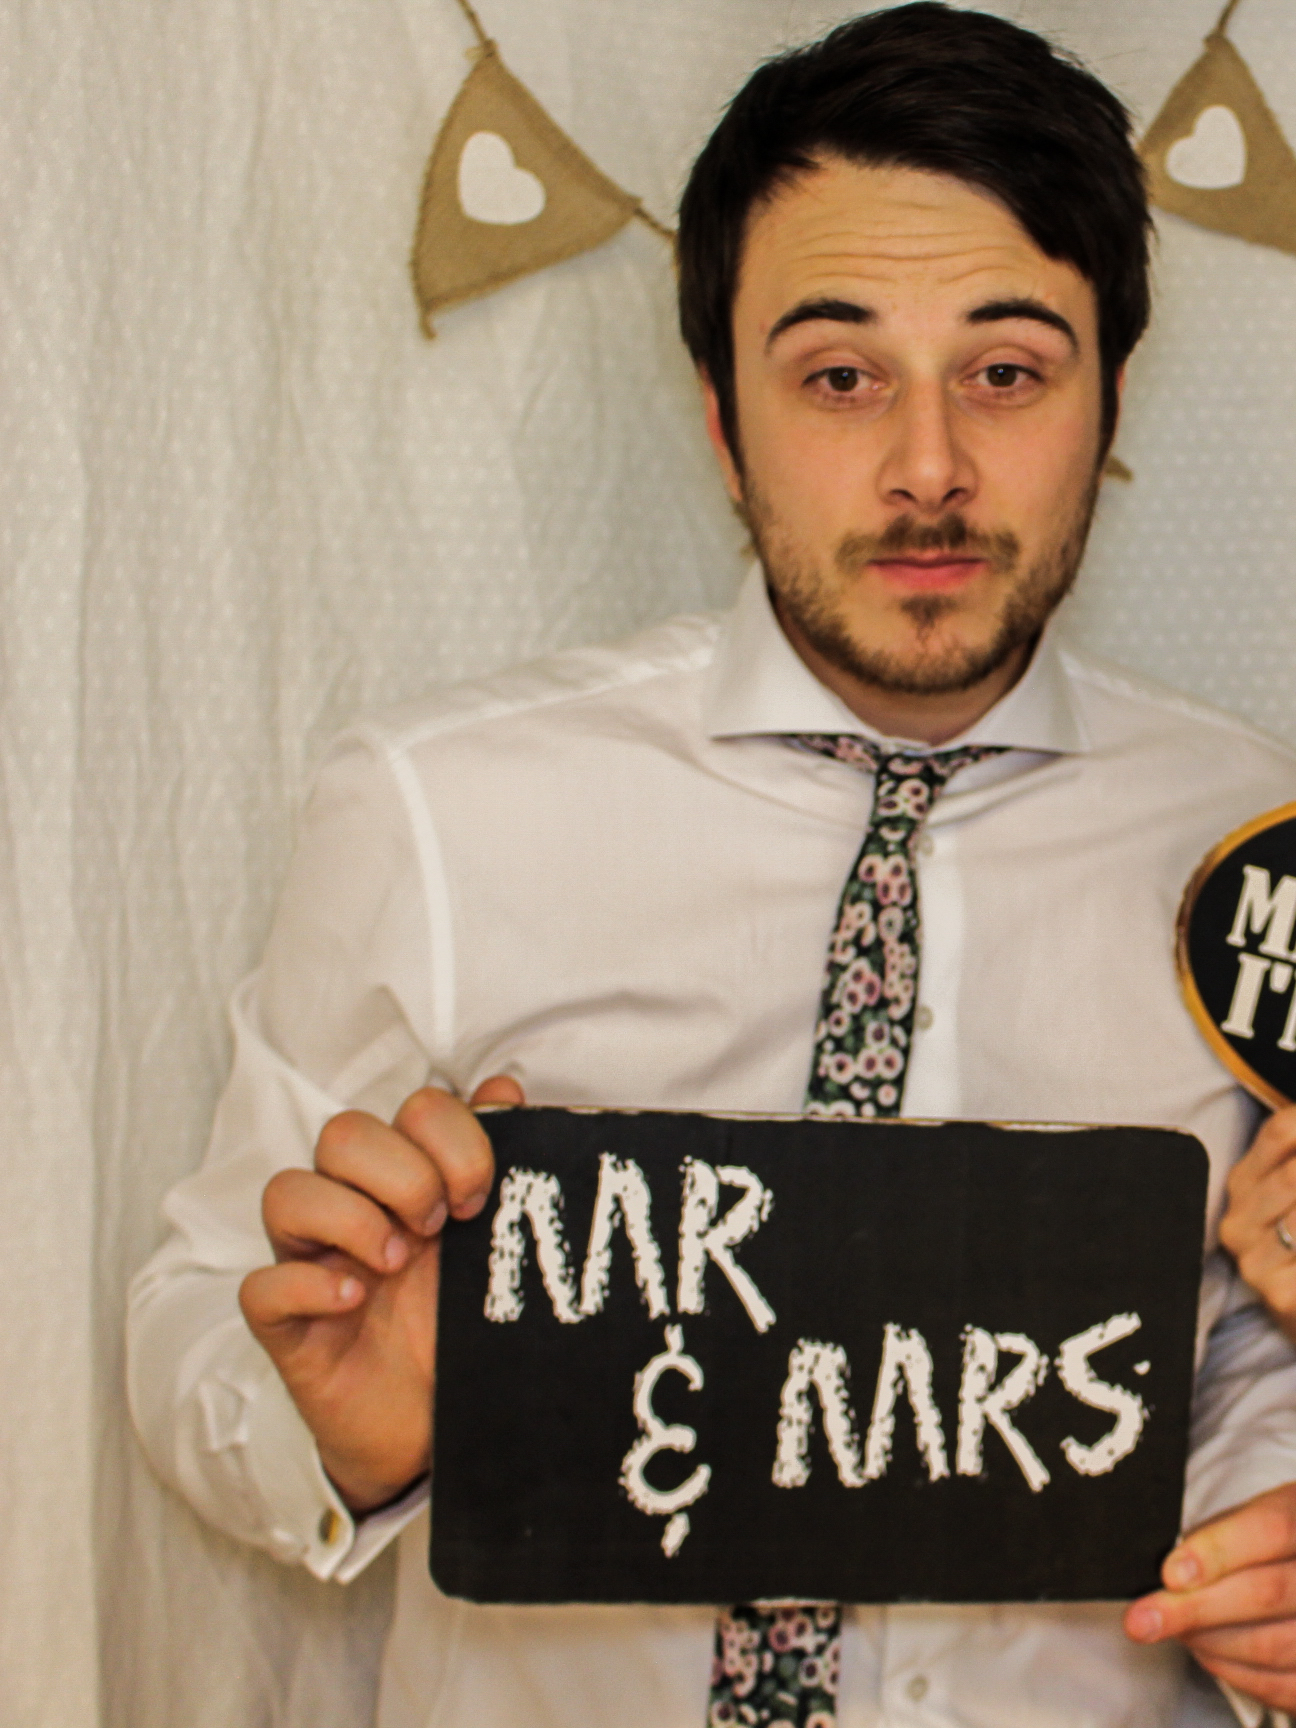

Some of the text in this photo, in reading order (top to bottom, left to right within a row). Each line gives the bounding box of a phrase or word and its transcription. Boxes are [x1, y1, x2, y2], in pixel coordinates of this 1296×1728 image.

[483, 1151, 776, 1333] MR
[618, 1312, 1151, 1557] & MRS
